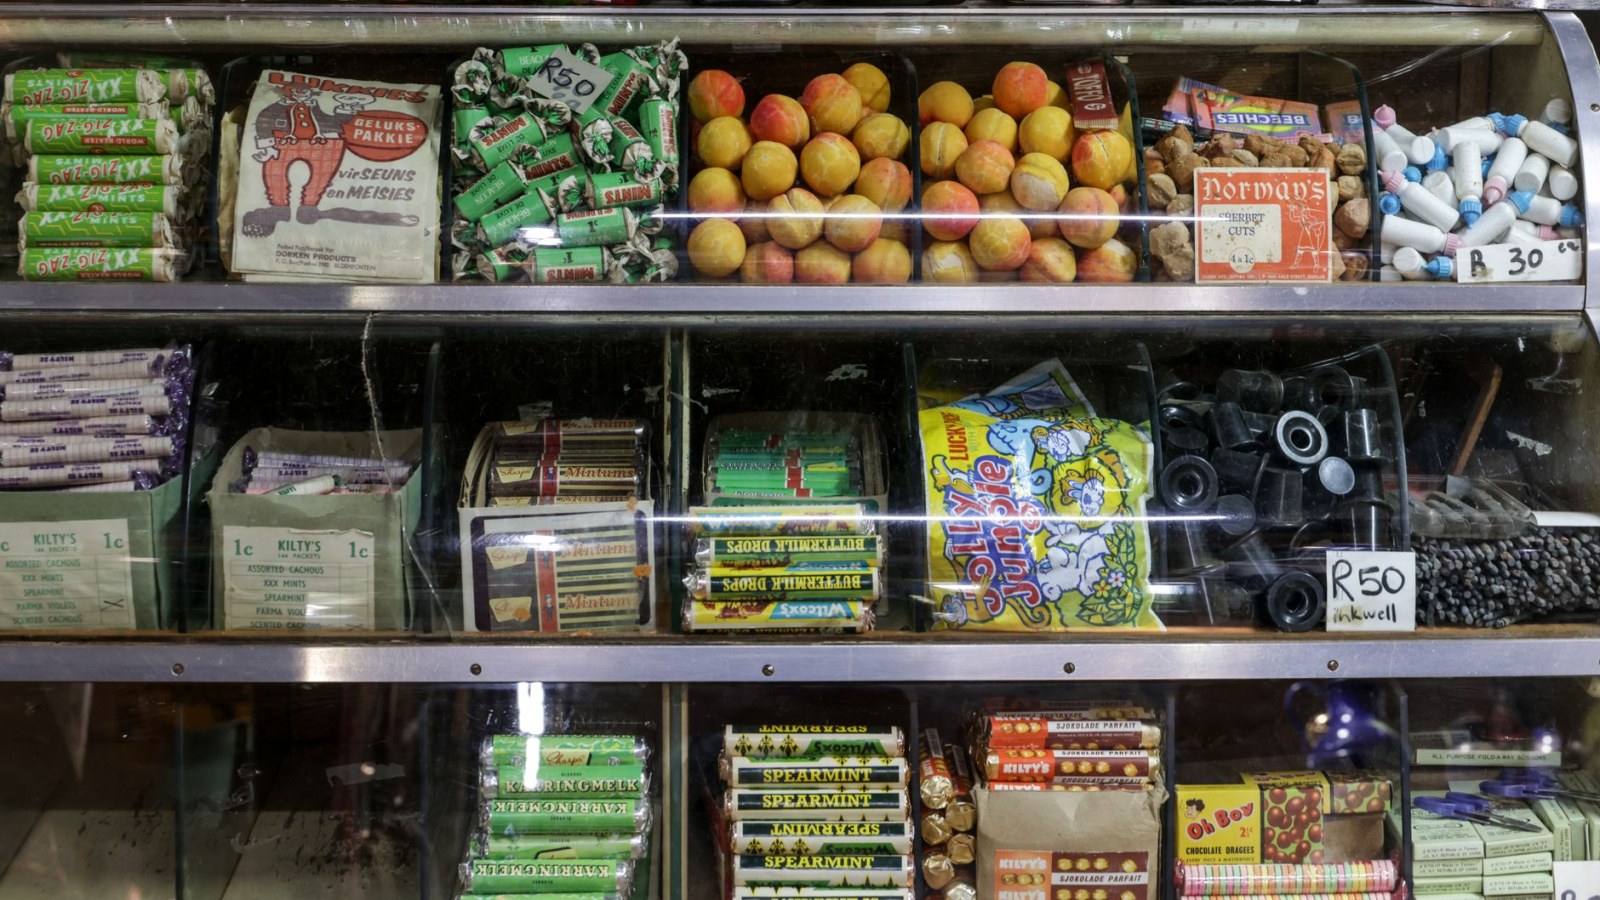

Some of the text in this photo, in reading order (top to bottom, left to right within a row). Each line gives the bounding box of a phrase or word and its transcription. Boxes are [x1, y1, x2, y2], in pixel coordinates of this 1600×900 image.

[538, 57, 596, 97] R50
[1215, 112, 1307, 126] BEECHIES
[353, 129, 414, 144] PAKKIE
[481, 117, 528, 148] MINTS
[338, 168, 417, 182] vir SEUNS
[526, 155, 573, 181] MINTS
[326, 186, 415, 201] en MEISIES
[604, 185, 652, 205] MINTS
[1202, 177, 1325, 200] Norman's
[1218, 213, 1265, 223] SHERBET
[1228, 226, 1256, 236] CUTS
[38, 249, 109, 276] ZIG-ZAG
[313, 253, 357, 263] PRODUCTS
[1469, 249, 1488, 277] R
[1508, 247, 1543, 276] 30
[546, 267, 594, 282] MINTS
[565, 467, 635, 478] Mintums
[33, 533, 77, 546] KILTY'S
[103, 532, 124, 549] 1c
[727, 538, 864, 553] BUTTERMILK DROPS
[233, 539, 369, 558] 1c KILTY'S 1c
[46, 558, 81, 567] CACHOUS
[247, 565, 324, 574] ASSORTED CACHOUS
[40, 574, 64, 582] MINTS
[264, 580, 306, 589] XXX MINTS
[723, 575, 861, 591] BUTTERMILK DROPS
[1332, 559, 1406, 602] R50
[23, 588, 64, 597] SPEARMINT
[264, 593, 306, 601] SPEARMINT
[256, 607, 282, 615] PARMA
[780, 602, 847, 617] Wilcox's
[1333, 603, 1397, 624] inkwell
[1056, 721, 1137, 730] SJOKOLADE PARFAIT
[814, 741, 878, 755] Wilcox's
[1003, 760, 1050, 773] KILTY'S
[763, 768, 873, 783] SPEARMINT
[506, 779, 639, 793] KARINGMELK
[496, 802, 628, 814] KARRINGMELK
[762, 794, 872, 809] SPEARMINT
[770, 823, 880, 836] SPEARMINT
[1187, 819, 1216, 840] Oh
[1186, 846, 1255, 855] CHOCOLATE DRAGEES
[764, 856, 875, 869] SPEARMINT
[997, 857, 1047, 870] KILTY'S
[477, 864, 609, 877] KARRINGMELK
[1059, 875, 1142, 883] SJOKOLADE PARFAIT
